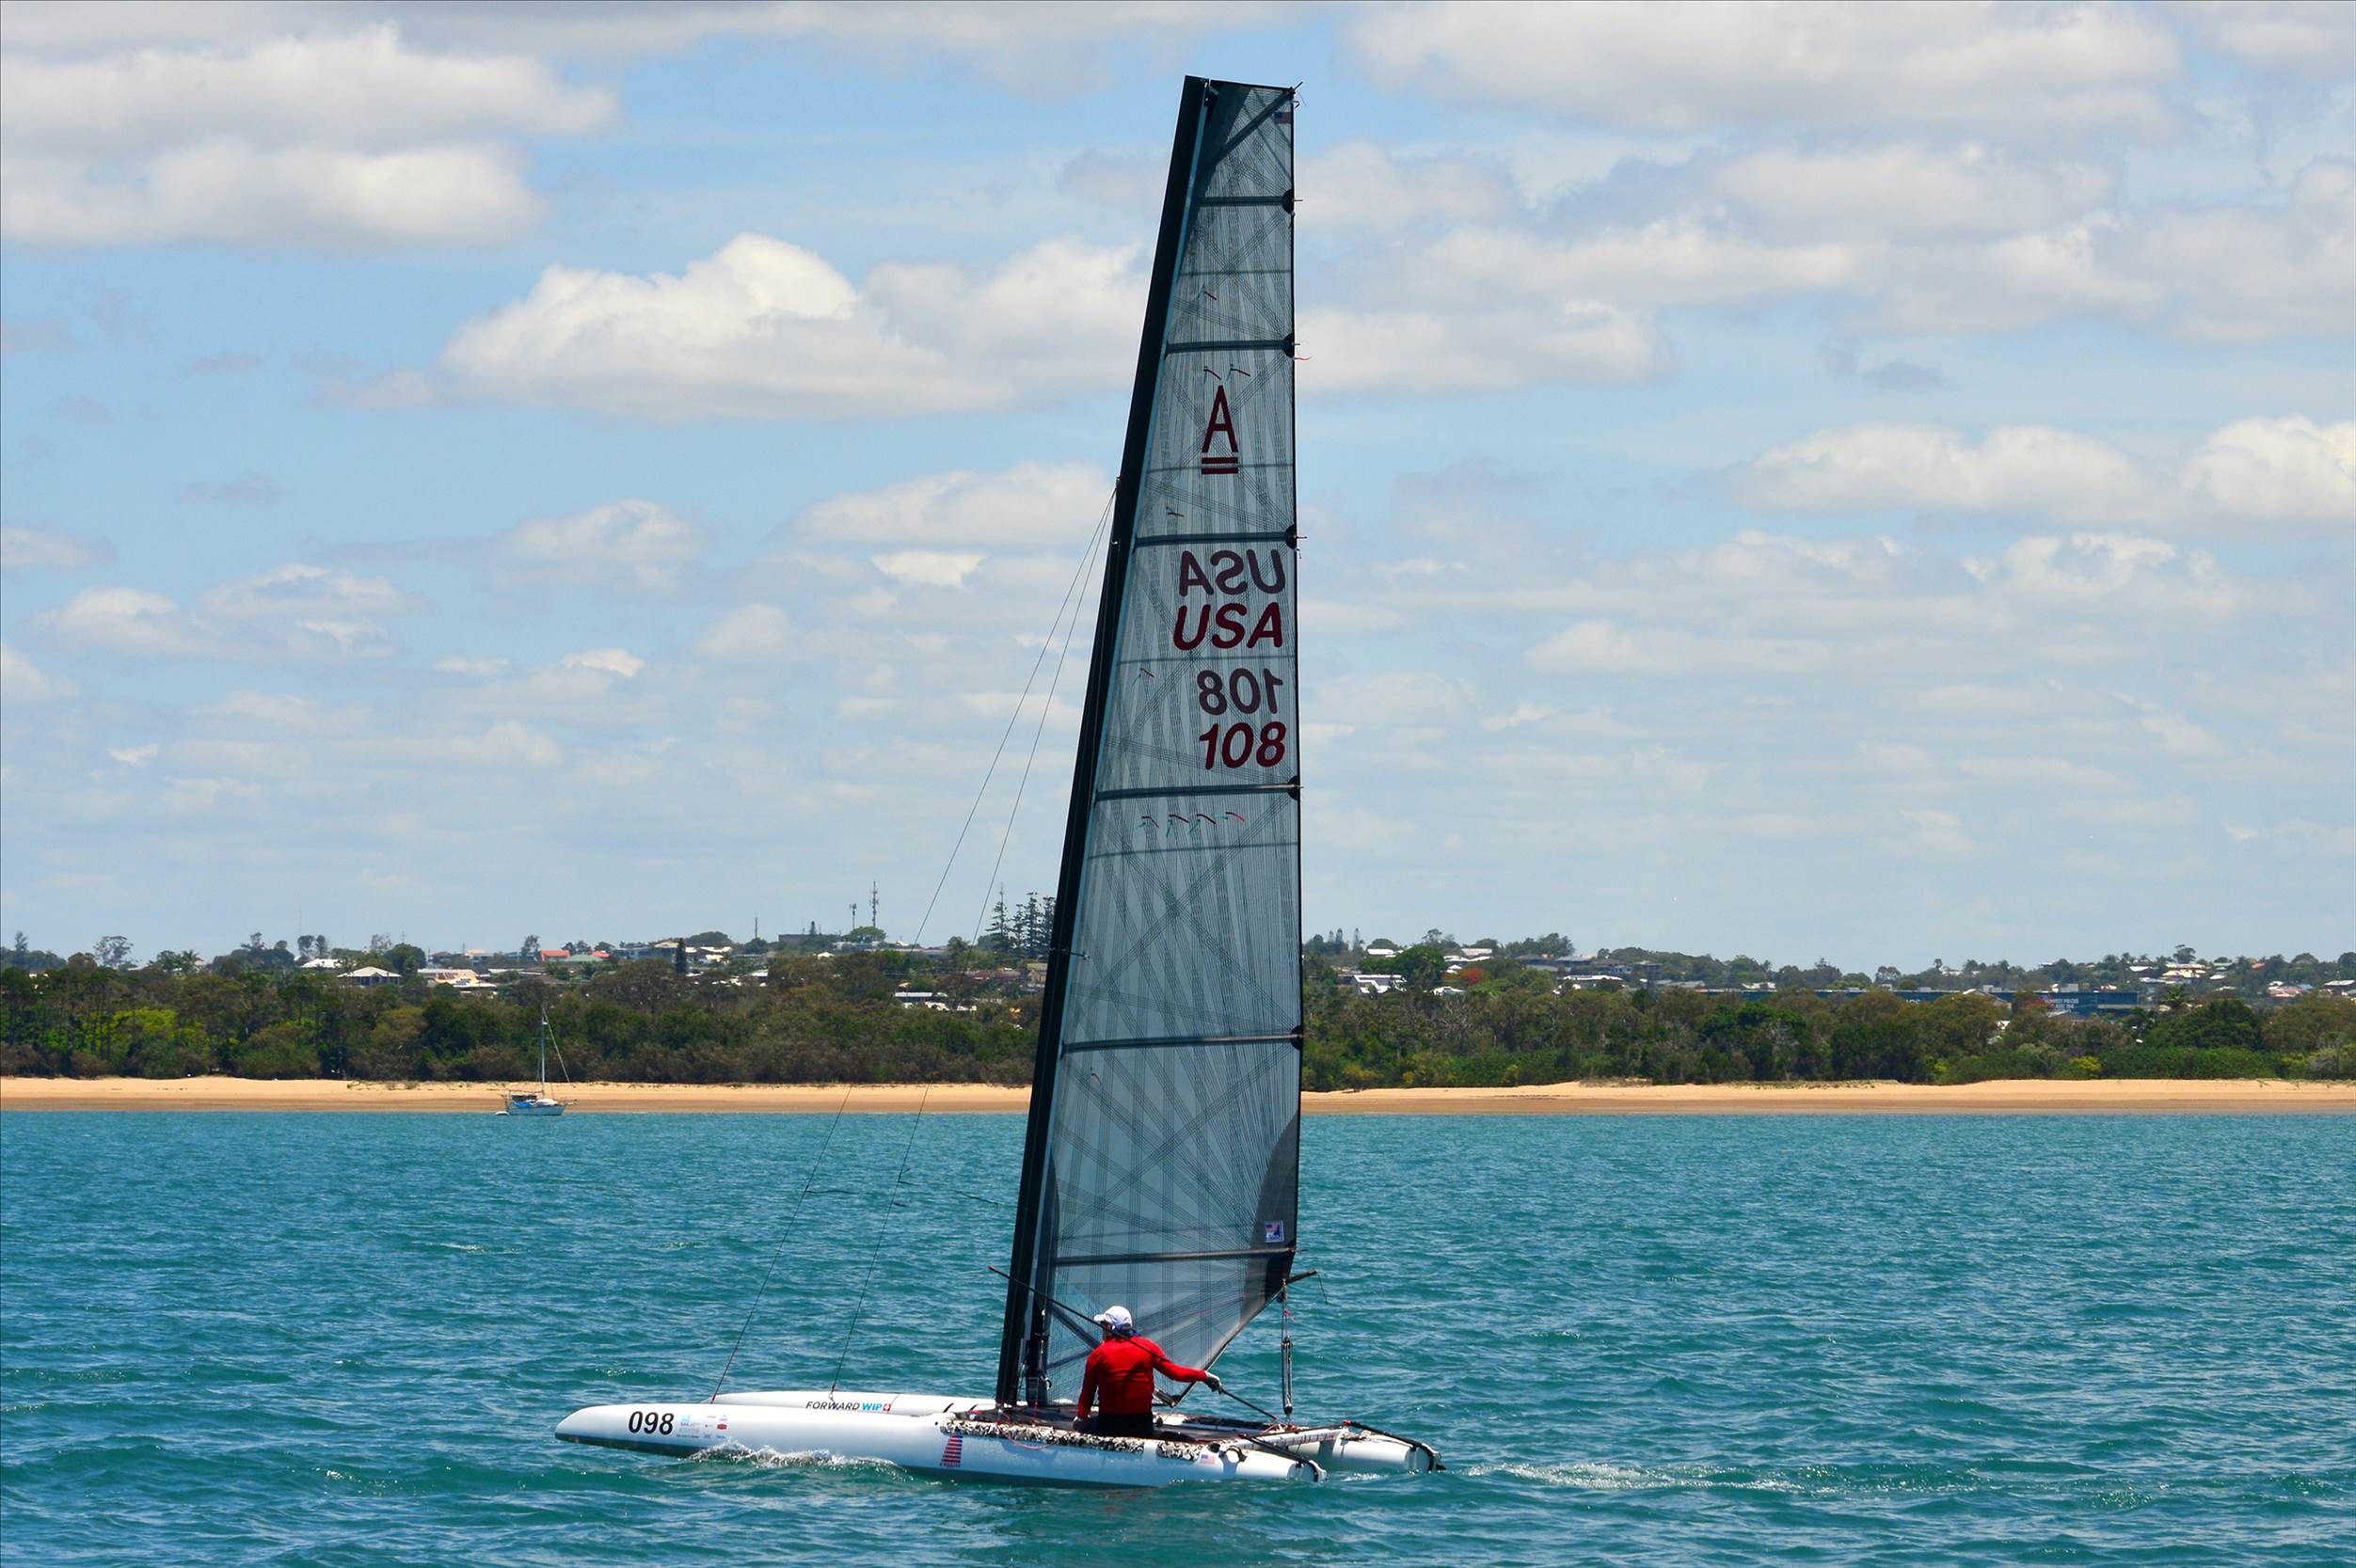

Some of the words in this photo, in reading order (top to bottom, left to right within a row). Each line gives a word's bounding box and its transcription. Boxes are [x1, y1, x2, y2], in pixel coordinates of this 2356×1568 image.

[1202, 385, 1239, 452] A
[1173, 602, 1283, 651] USA
[1200, 721, 1287, 769] 108
[629, 1410, 675, 1435] 098
[805, 1401, 860, 1411] FORWARD
[862, 1402, 883, 1411] WIP
